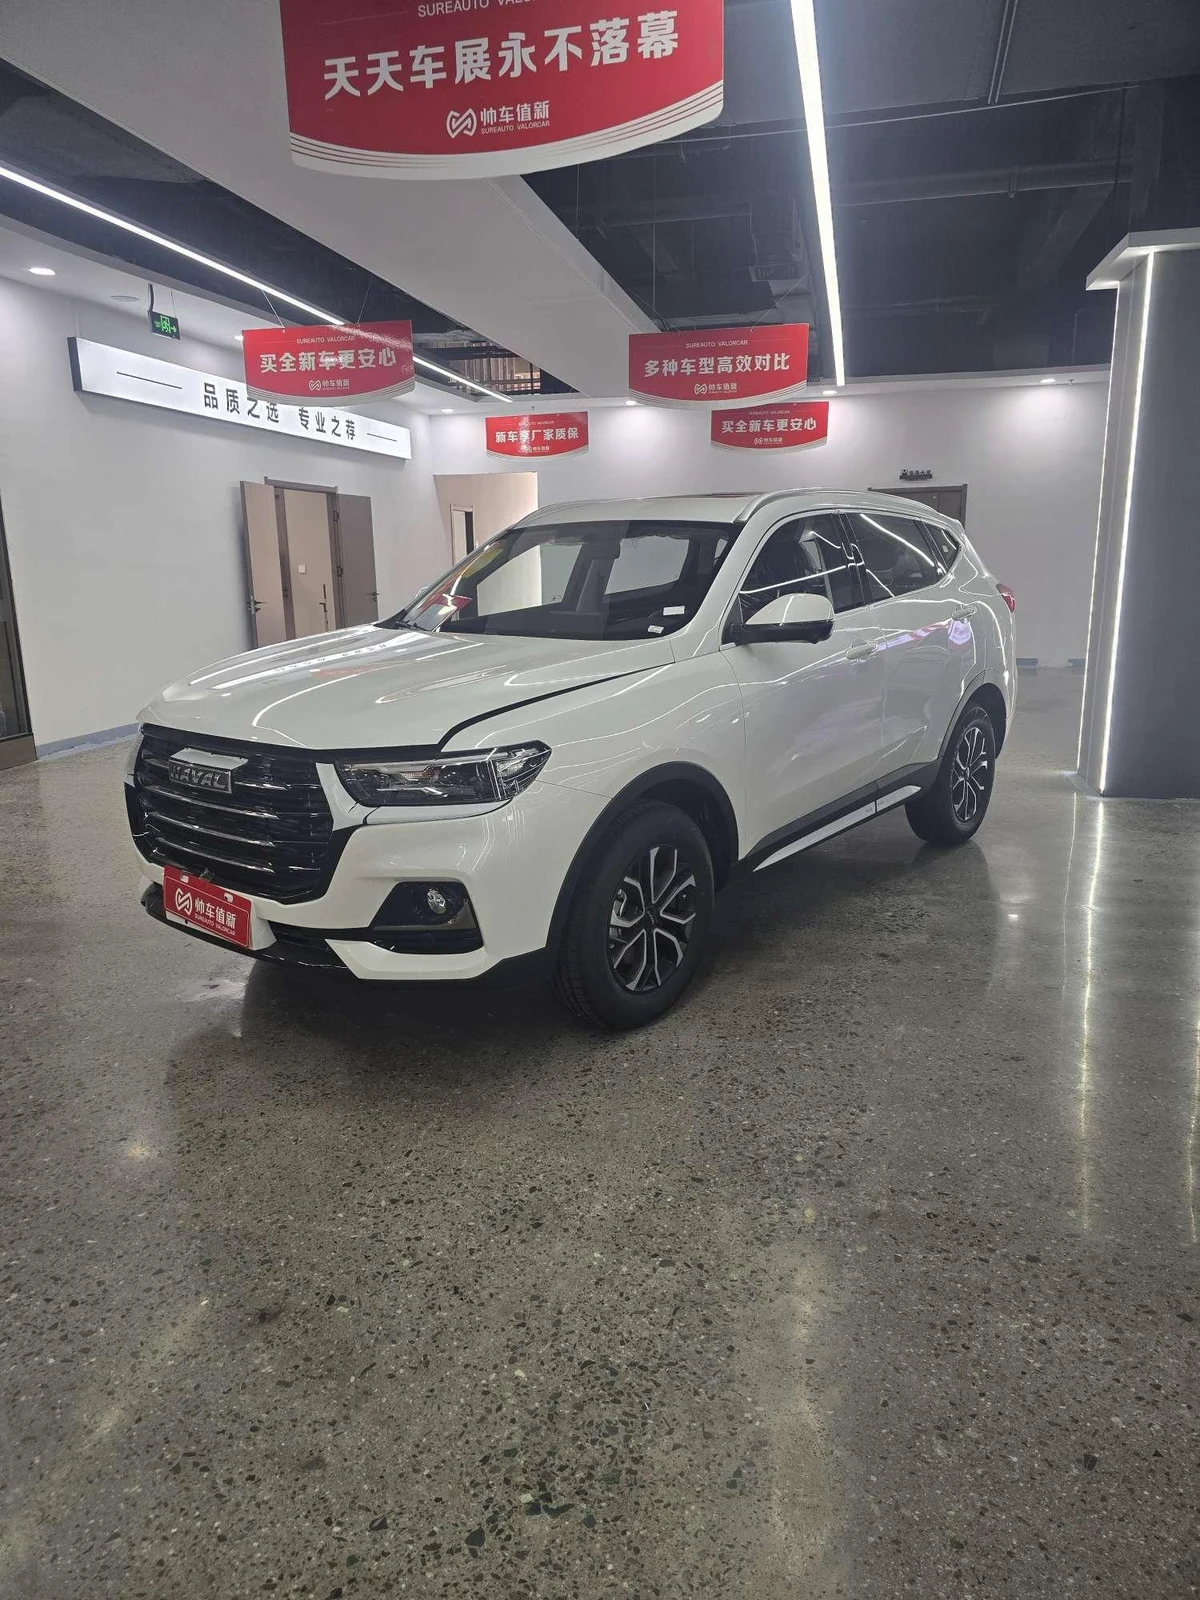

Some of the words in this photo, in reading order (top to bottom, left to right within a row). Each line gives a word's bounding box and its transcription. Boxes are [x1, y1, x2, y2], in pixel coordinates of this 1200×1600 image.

[418, 0, 489, 18] SUREAUTO
[323, 10, 679, 101] 天天车展永不落幕
[480, 100, 550, 126] 帅车值新
[481, 124, 514, 135] SUREAUTO
[517, 120, 551, 130] VALORCAR
[718, 339, 748, 347] VALORCAR
[259, 347, 397, 374] 买全新车更安心
[644, 352, 791, 378] 多种车型高效对比
[203, 381, 280, 424] 品质之选
[298, 406, 356, 441] 专业之荐
[721, 417, 817, 434] 买全新车更安心
[195, 898, 236, 929] 帅车值新
